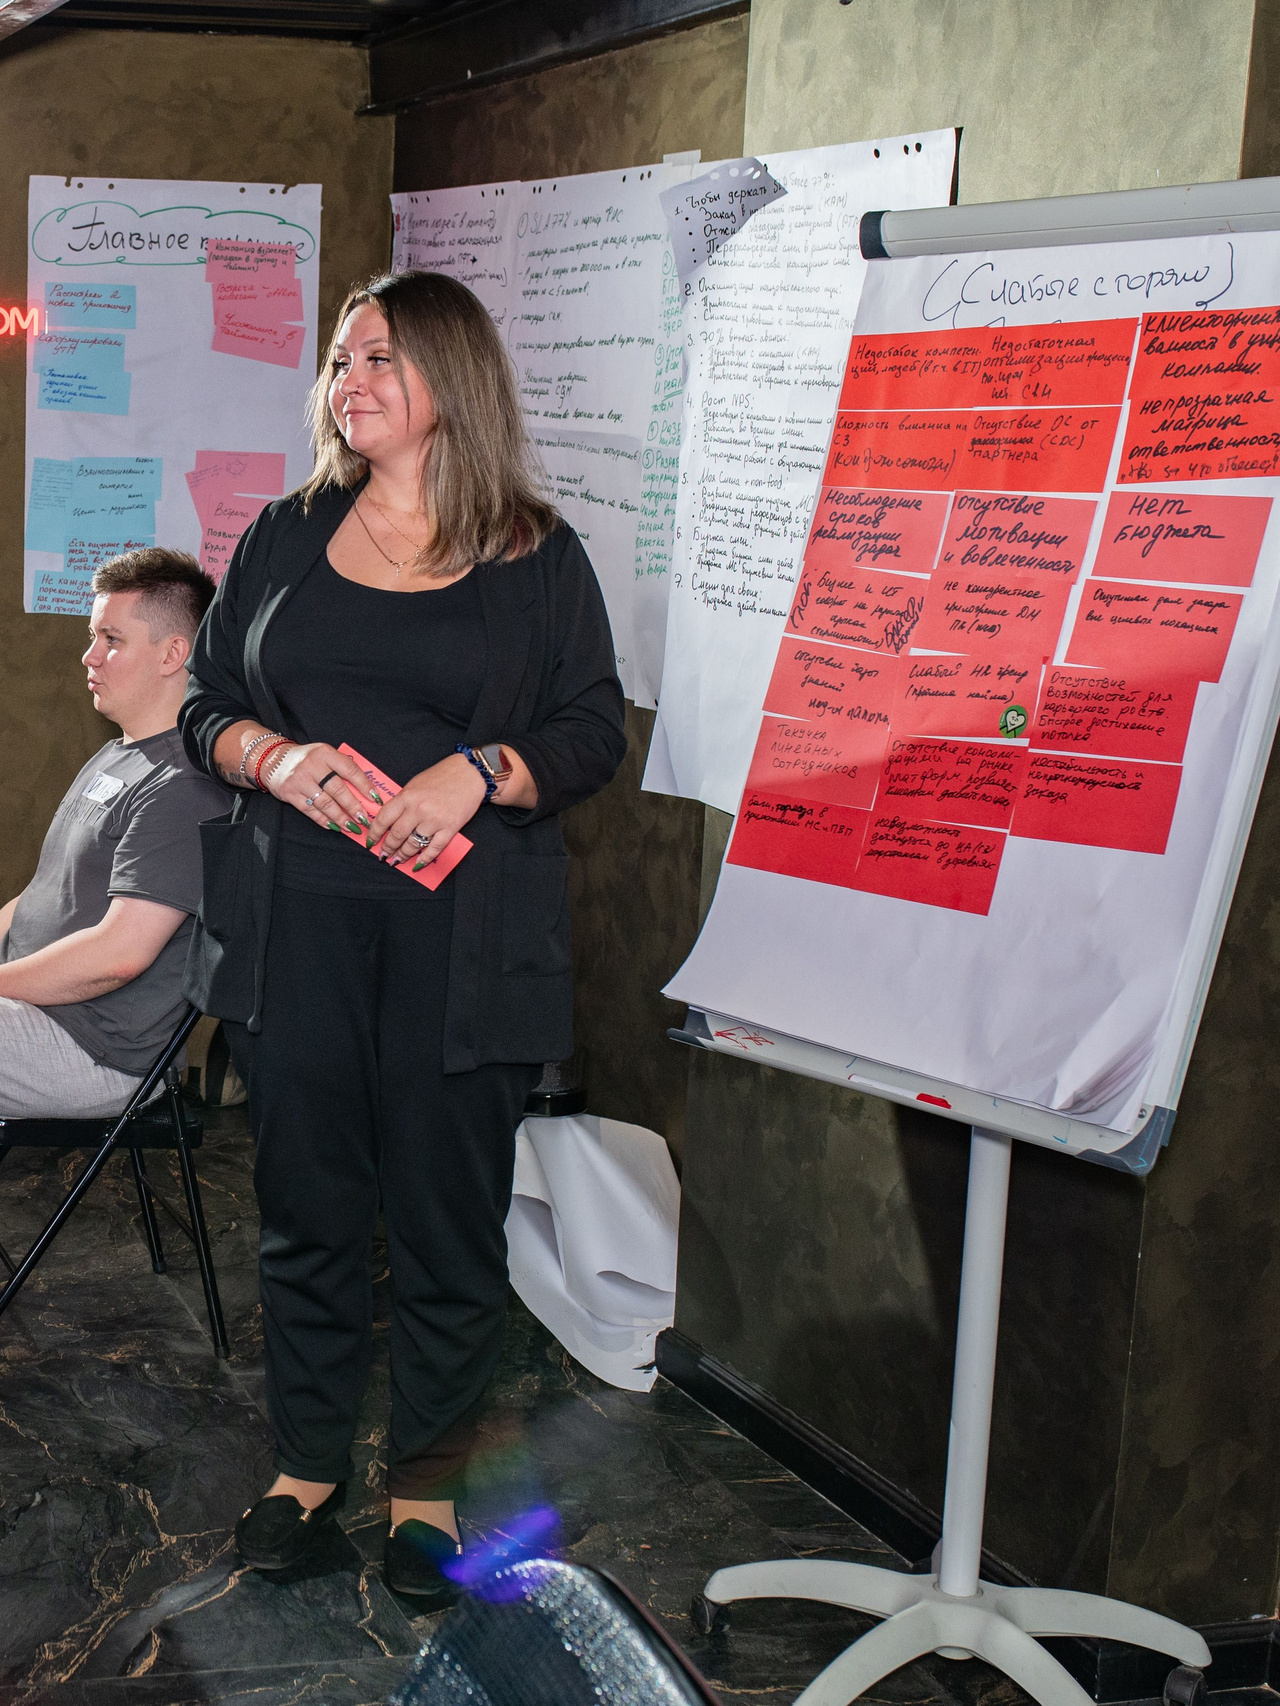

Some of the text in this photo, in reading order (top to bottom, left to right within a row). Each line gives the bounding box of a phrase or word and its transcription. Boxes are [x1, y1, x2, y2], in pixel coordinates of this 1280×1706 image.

[68, 206, 189, 251] Главное
[829, 511, 886, 528] сроков
[1051, 671, 1126, 689] Отсутствие
[1143, 692, 1172, 708] для
[778, 724, 827, 740] Текучка
[771, 742, 842, 758] линейных
